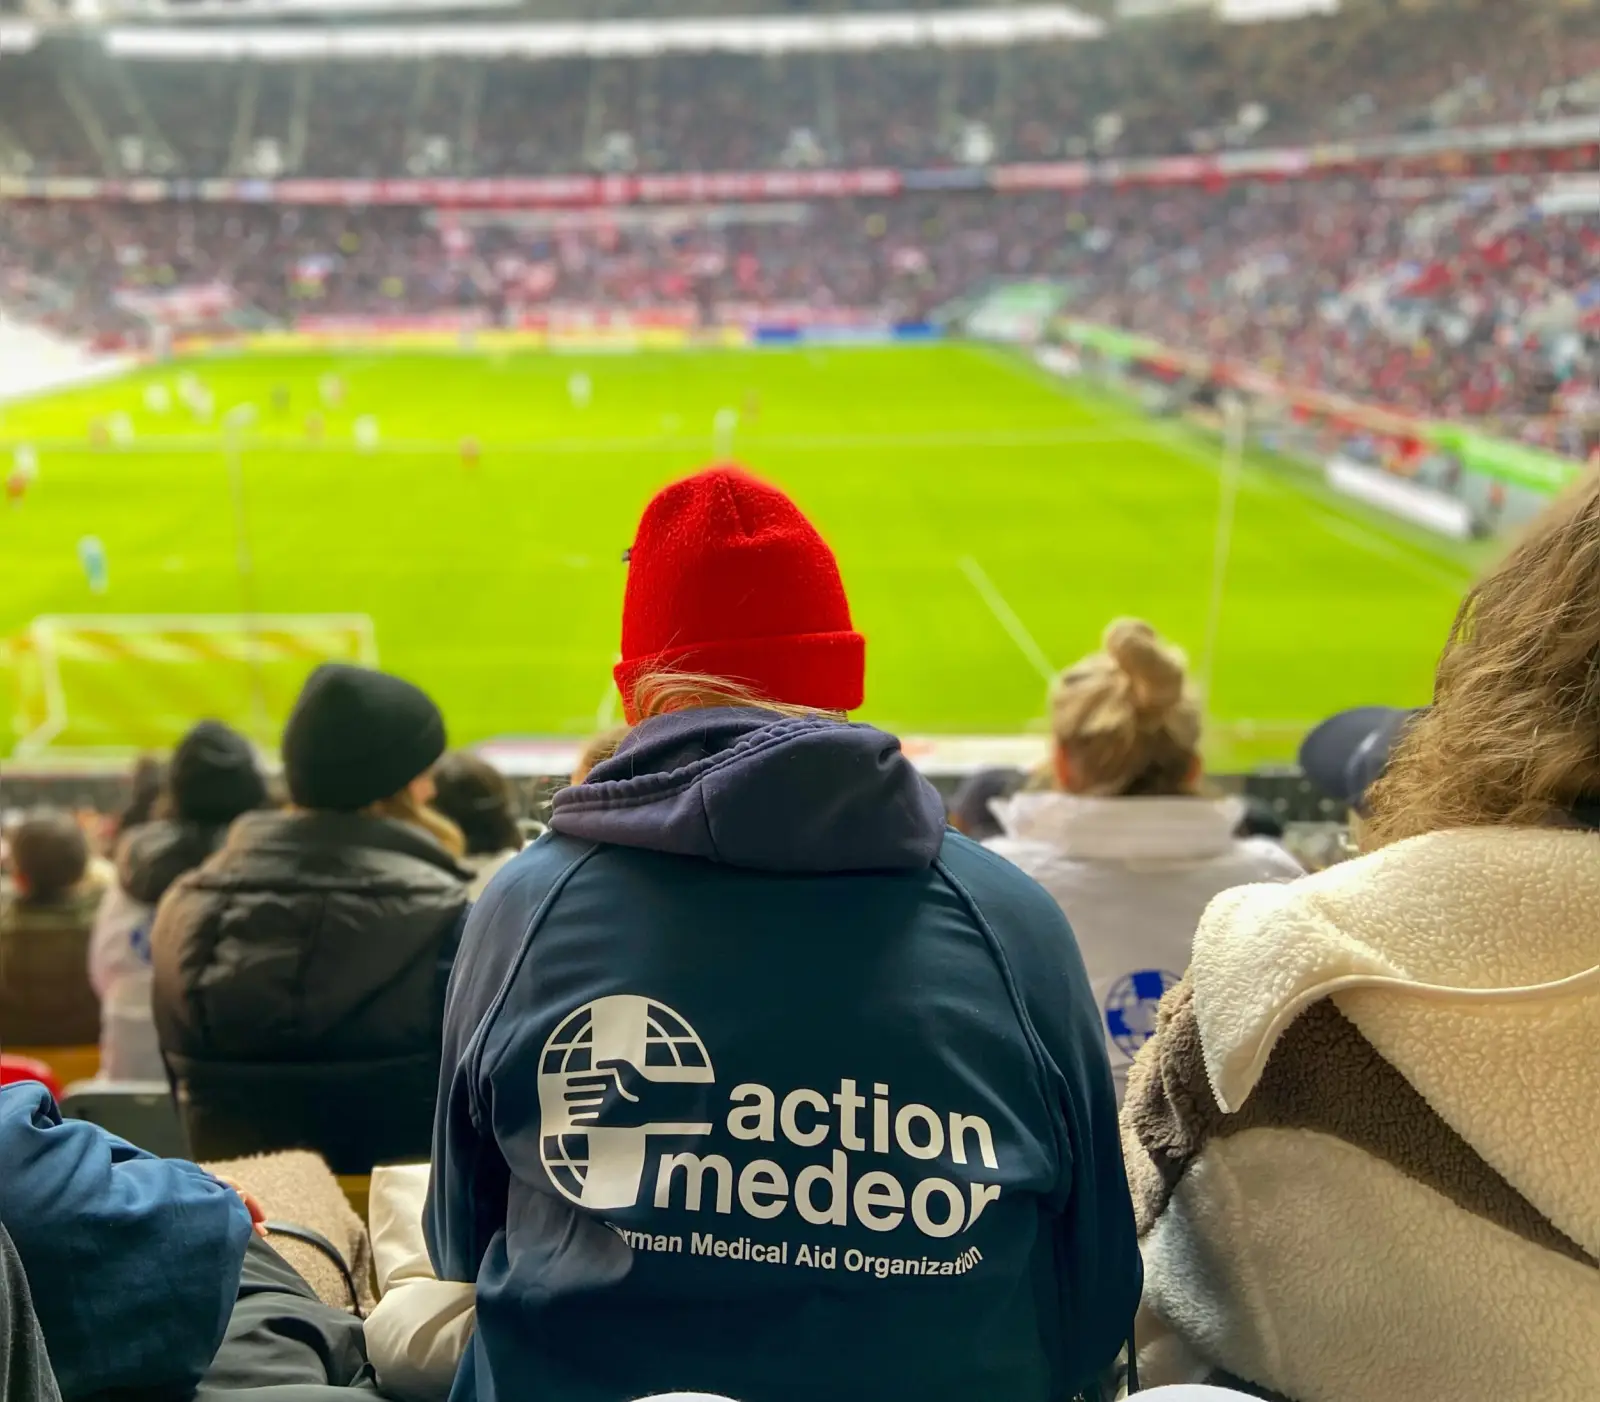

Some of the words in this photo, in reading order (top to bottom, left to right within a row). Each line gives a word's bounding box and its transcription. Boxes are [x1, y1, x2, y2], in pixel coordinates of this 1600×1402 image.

[726, 1078, 999, 1169] action
[654, 1149, 1001, 1238] medeor
[606, 1222, 682, 1253] rman
[691, 1232, 788, 1264] Medical
[795, 1243, 836, 1270] Aid
[844, 1246, 983, 1278] Organization
